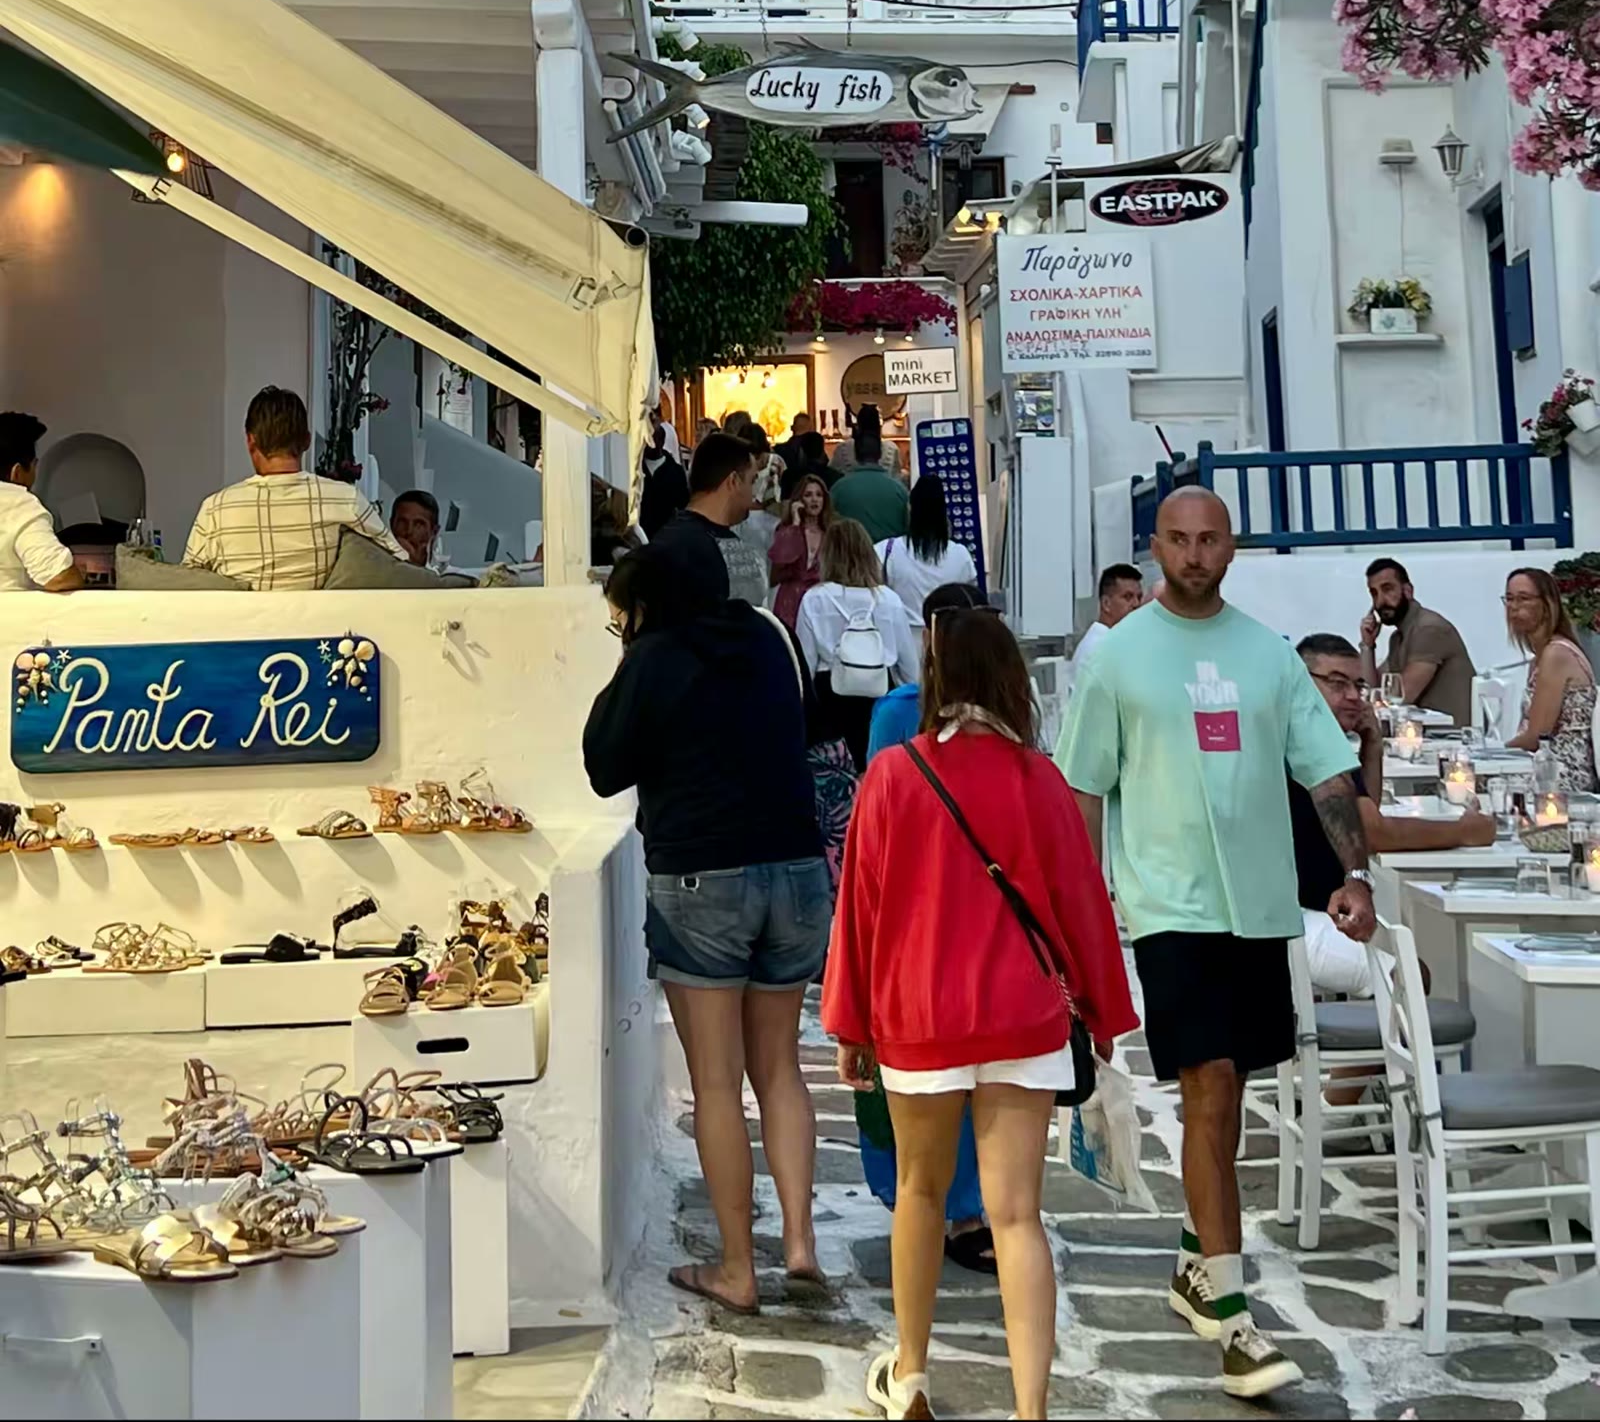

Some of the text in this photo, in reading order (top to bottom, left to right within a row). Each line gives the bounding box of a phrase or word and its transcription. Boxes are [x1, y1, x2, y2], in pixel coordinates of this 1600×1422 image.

[750, 70, 882, 110] Lucky fish
[1100, 190, 1218, 214] EASTPAK
[1010, 285, 1142, 302] ΣΧΟΛΙΚΑ-ΧΑΡΤΙΚΑ
[1030, 307, 1122, 321] ΓΡΑΦΙΚΗ ΥΛΗ
[891, 357, 923, 371] mini
[888, 371, 951, 387] MARKET
[43, 652, 350, 753] Panta Rei
